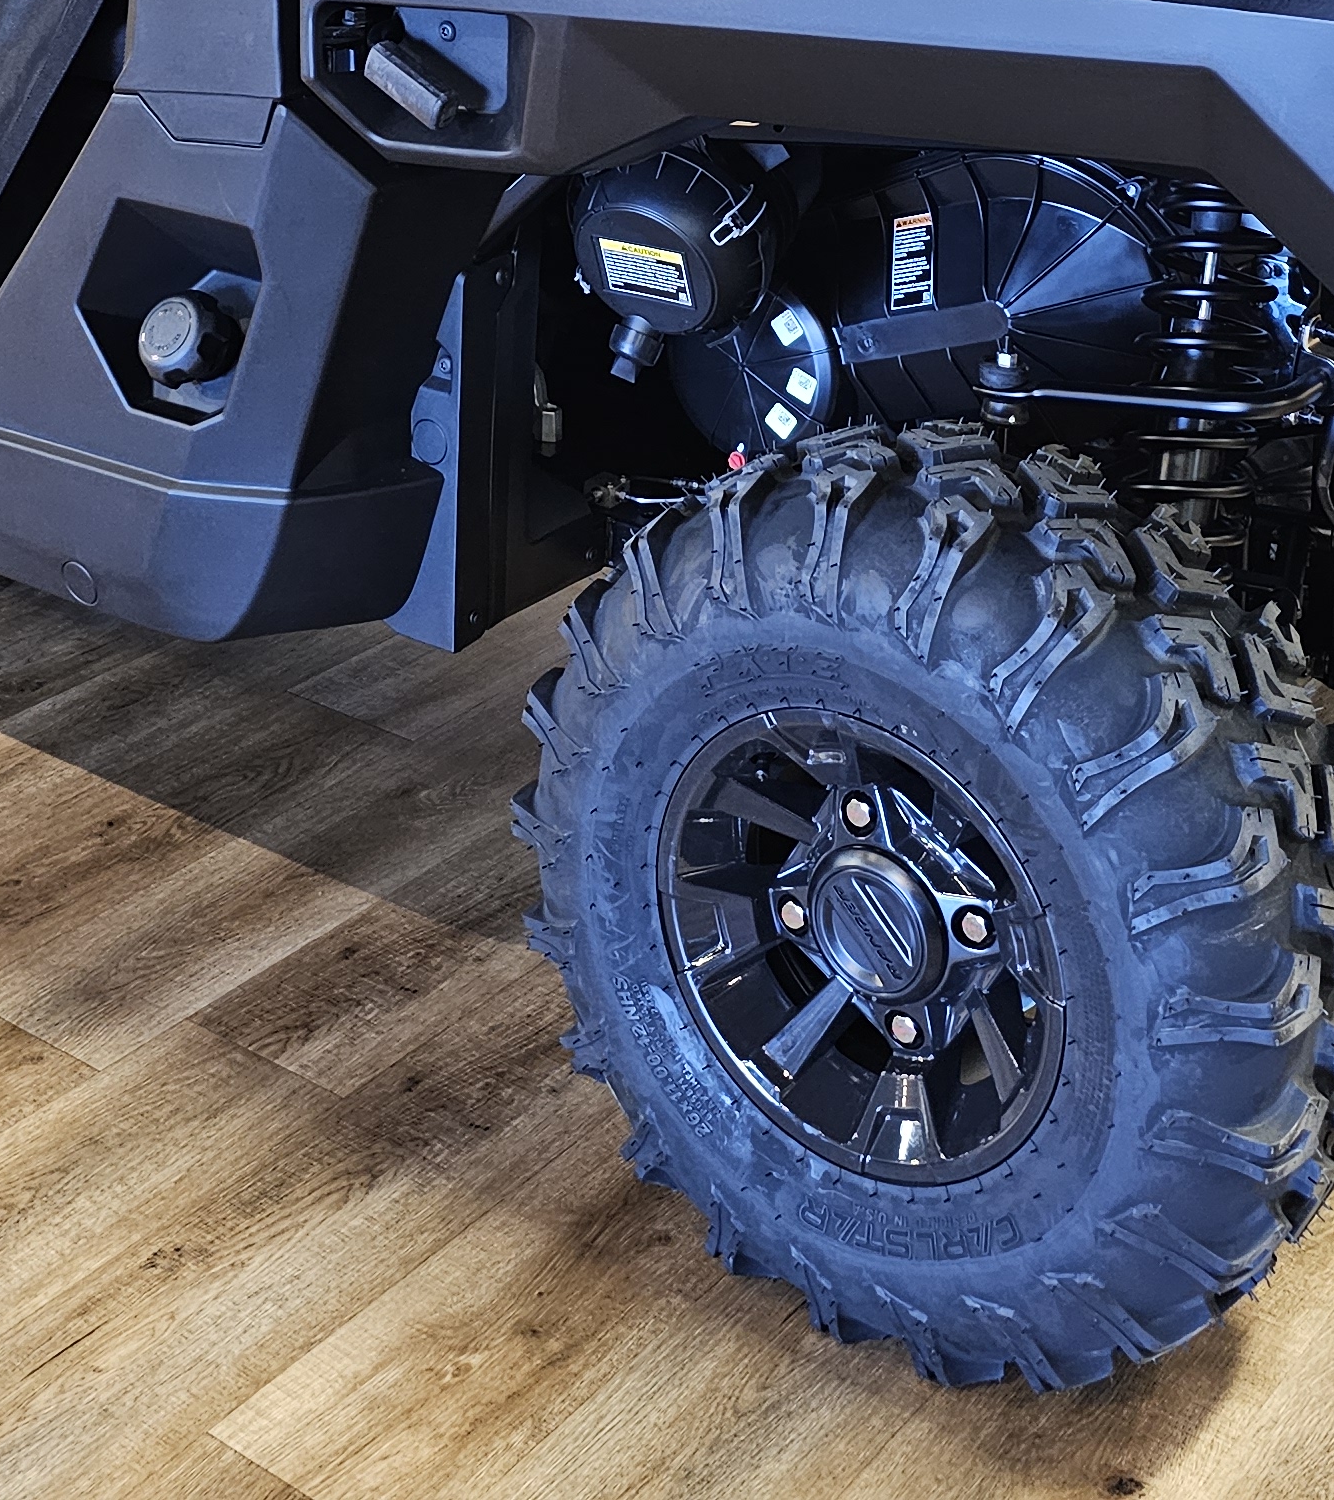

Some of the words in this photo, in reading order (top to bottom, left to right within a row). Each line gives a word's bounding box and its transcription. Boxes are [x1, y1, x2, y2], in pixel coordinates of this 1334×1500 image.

[627, 245, 662, 258] CAUTION
[612, 975, 642, 1023] NHS
[797, 1192, 1023, 1262] CARLSTAR
